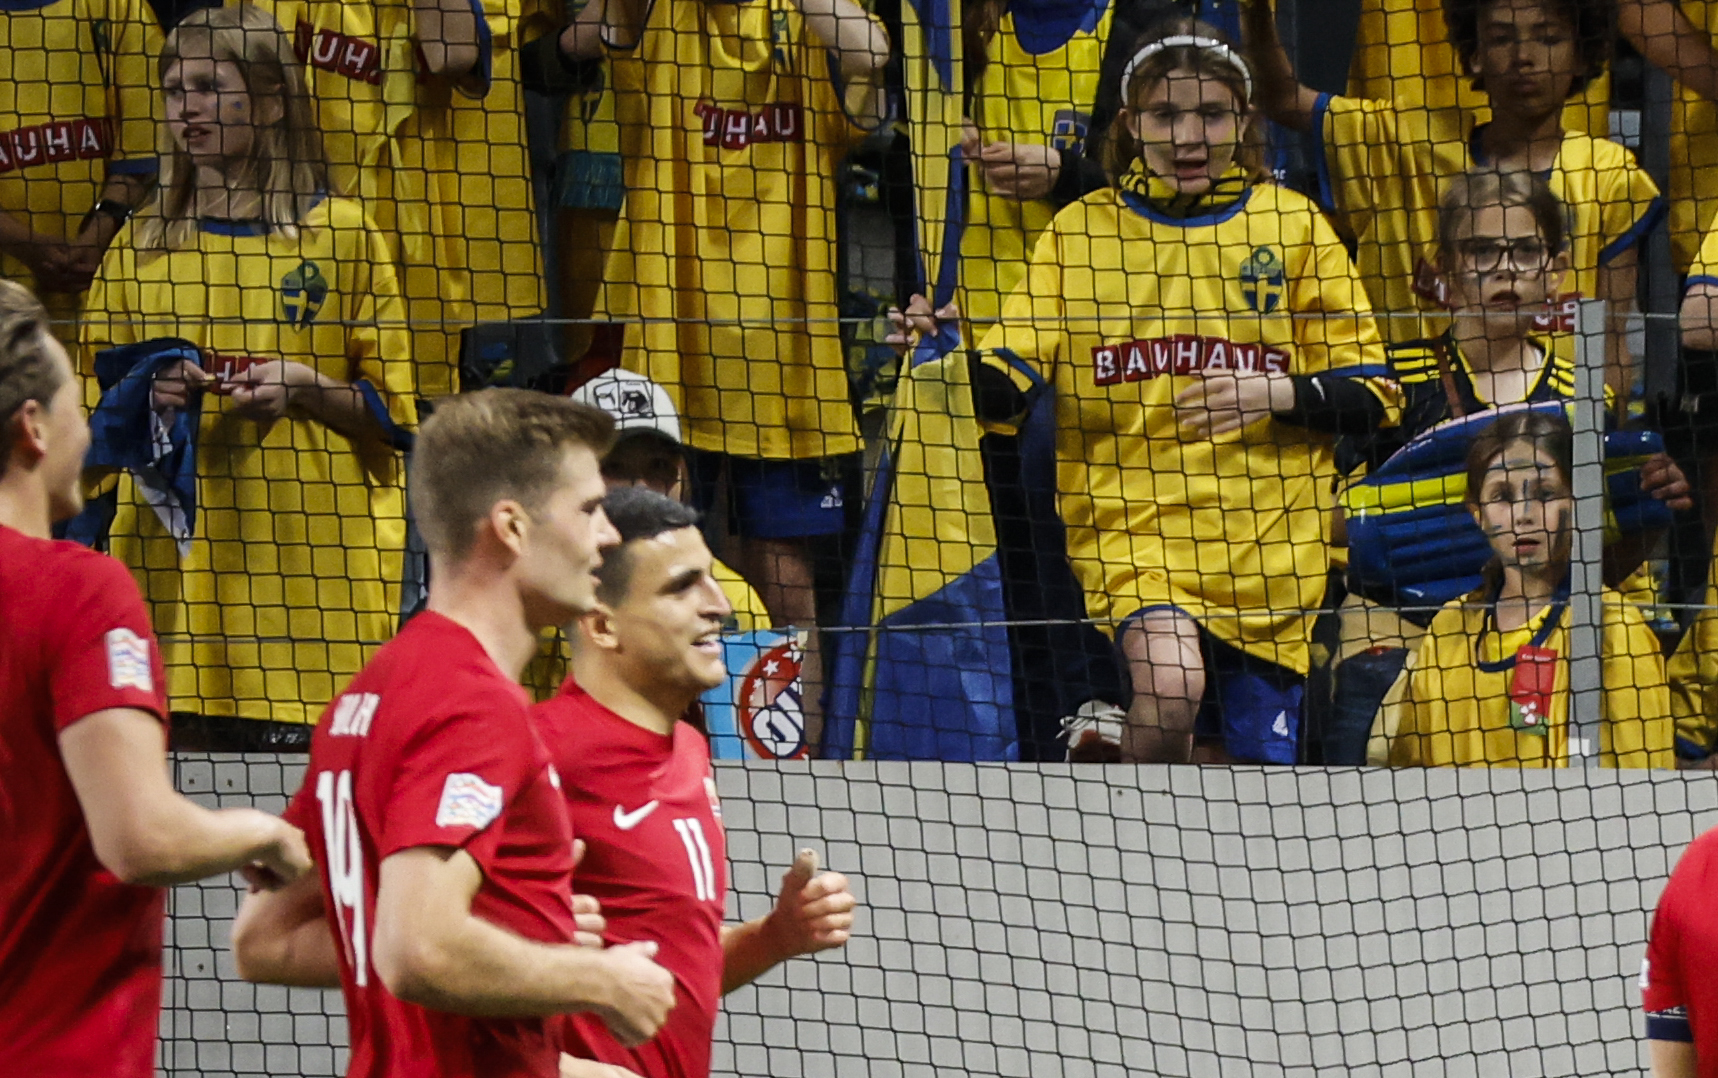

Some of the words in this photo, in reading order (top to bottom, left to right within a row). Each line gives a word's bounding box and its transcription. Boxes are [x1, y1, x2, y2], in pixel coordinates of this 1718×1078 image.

[1096, 341, 1284, 379] BAUHAUS
[315, 769, 368, 987] 14
[672, 817, 717, 902] 11
